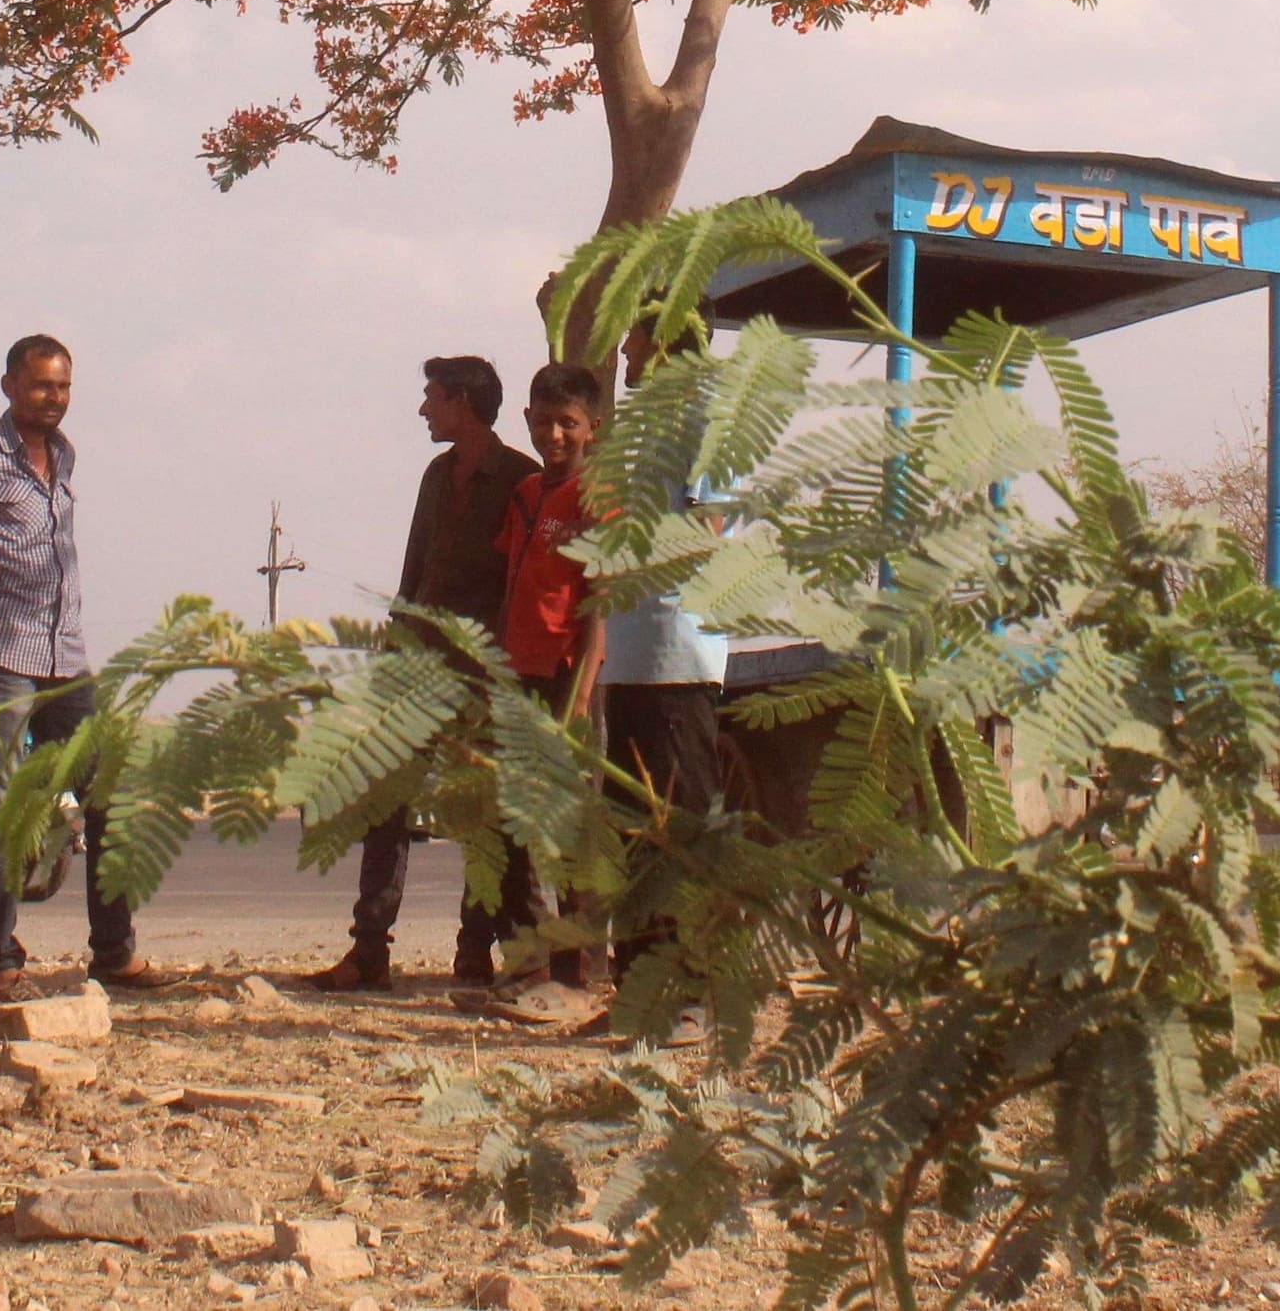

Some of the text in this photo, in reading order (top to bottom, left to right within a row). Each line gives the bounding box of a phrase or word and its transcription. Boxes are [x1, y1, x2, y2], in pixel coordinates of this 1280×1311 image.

[925, 172, 1247, 266] DJ वडा पाव
